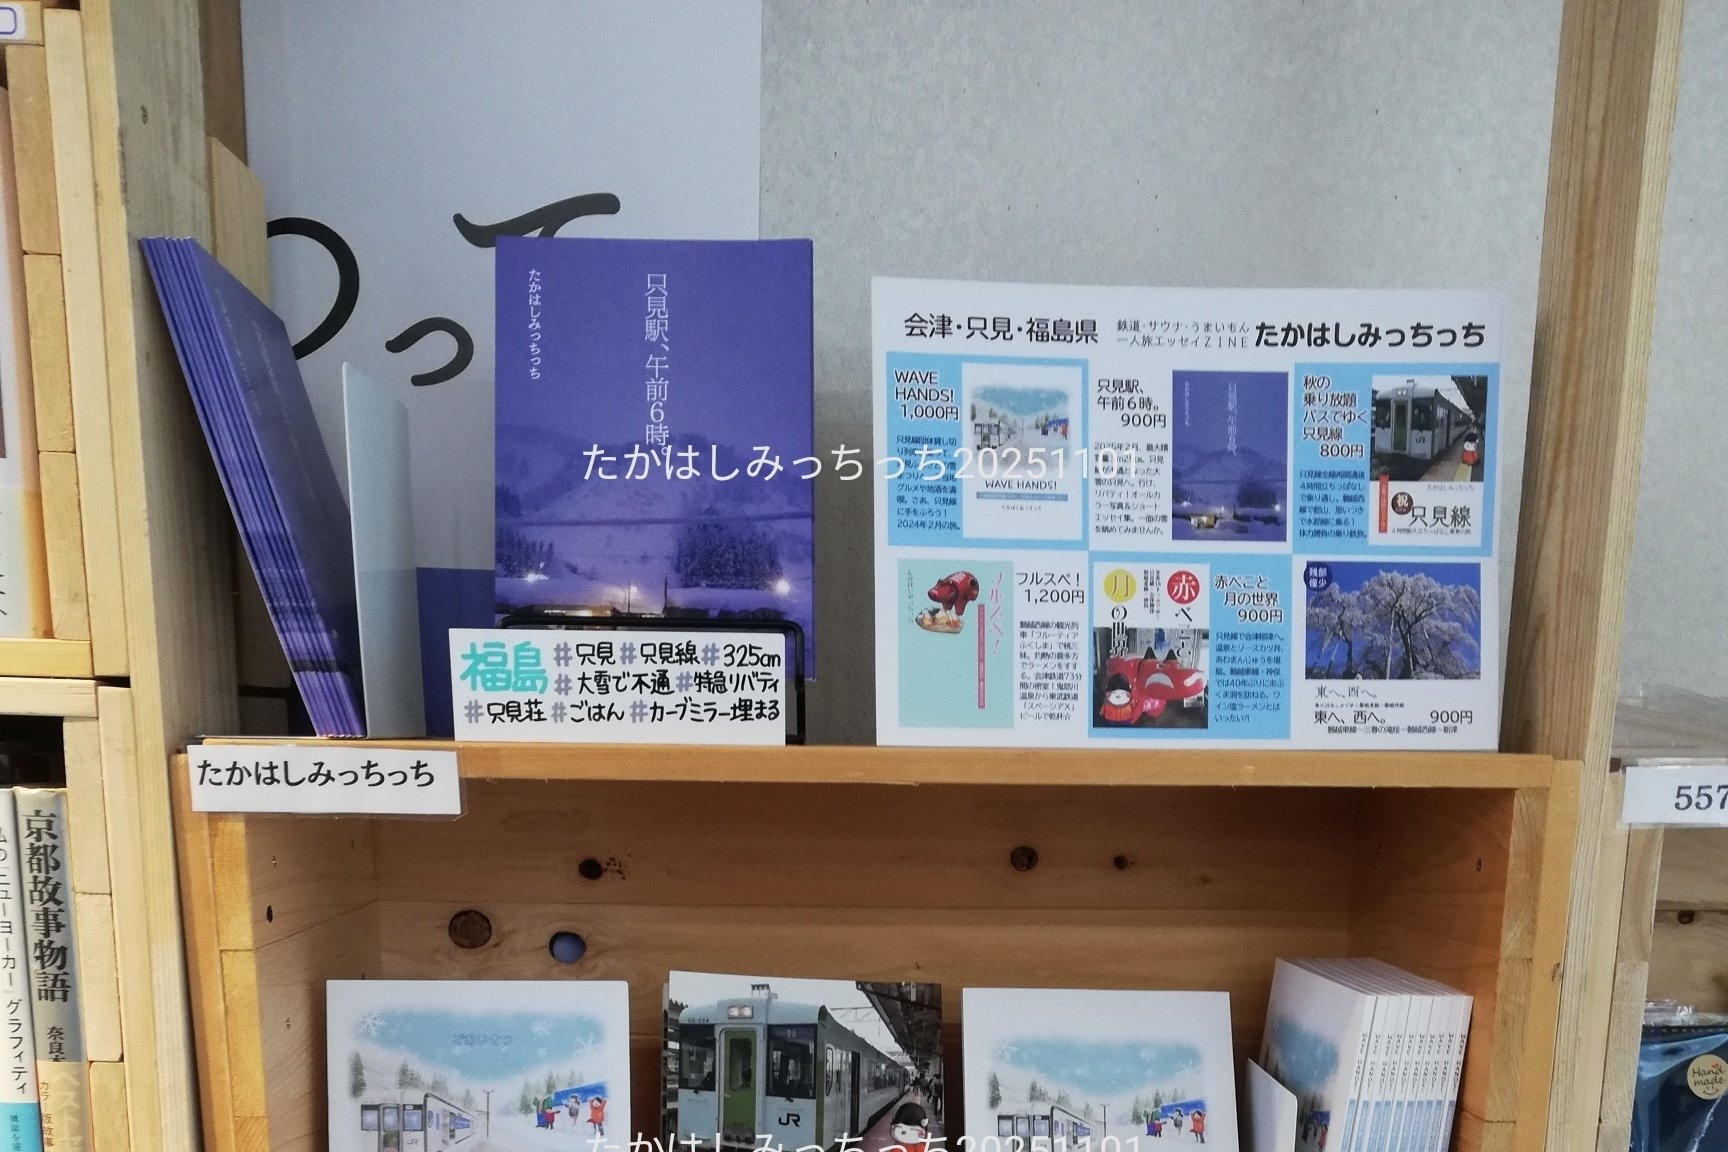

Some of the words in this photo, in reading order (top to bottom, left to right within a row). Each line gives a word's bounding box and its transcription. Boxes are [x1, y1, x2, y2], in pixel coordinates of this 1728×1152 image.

[528, 268, 542, 380] たかはしみっちっち
[903, 311, 1099, 345] 会津・只見・福島県
[1254, 321, 1486, 348] たかはしみっちっち
[894, 369, 939, 385] WAVE
[1303, 374, 1331, 390] 秋の
[1097, 378, 1144, 395] 只見駅、
[895, 387, 955, 403] HANDS!
[1303, 392, 1358, 408] 乗り放題
[1097, 395, 1161, 412] 午前6時。
[900, 404, 959, 421] 1,000円
[1303, 409, 1368, 425] パスでゆく
[1120, 413, 1167, 429] 900円
[1302, 427, 1344, 442] 只見線
[1319, 443, 1365, 459] 800円
[984, 480, 1012, 490] WAVE
[1408, 505, 1473, 528] 只見線
[1214, 574, 1269, 590] 赤べこと
[1024, 588, 1085, 604] 1,200円
[1223, 591, 1279, 607] 月の世界
[1237, 608, 1284, 623] 900円
[459, 641, 549, 695] 福島
[1314, 709, 1386, 725] 東へ、西へ。
[1430, 709, 1474, 724] 900円
[196, 758, 435, 789] たかはしみっちっち
[22, 809, 71, 1003] 京都故事物語
[778, 1112, 801, 1127] JR
